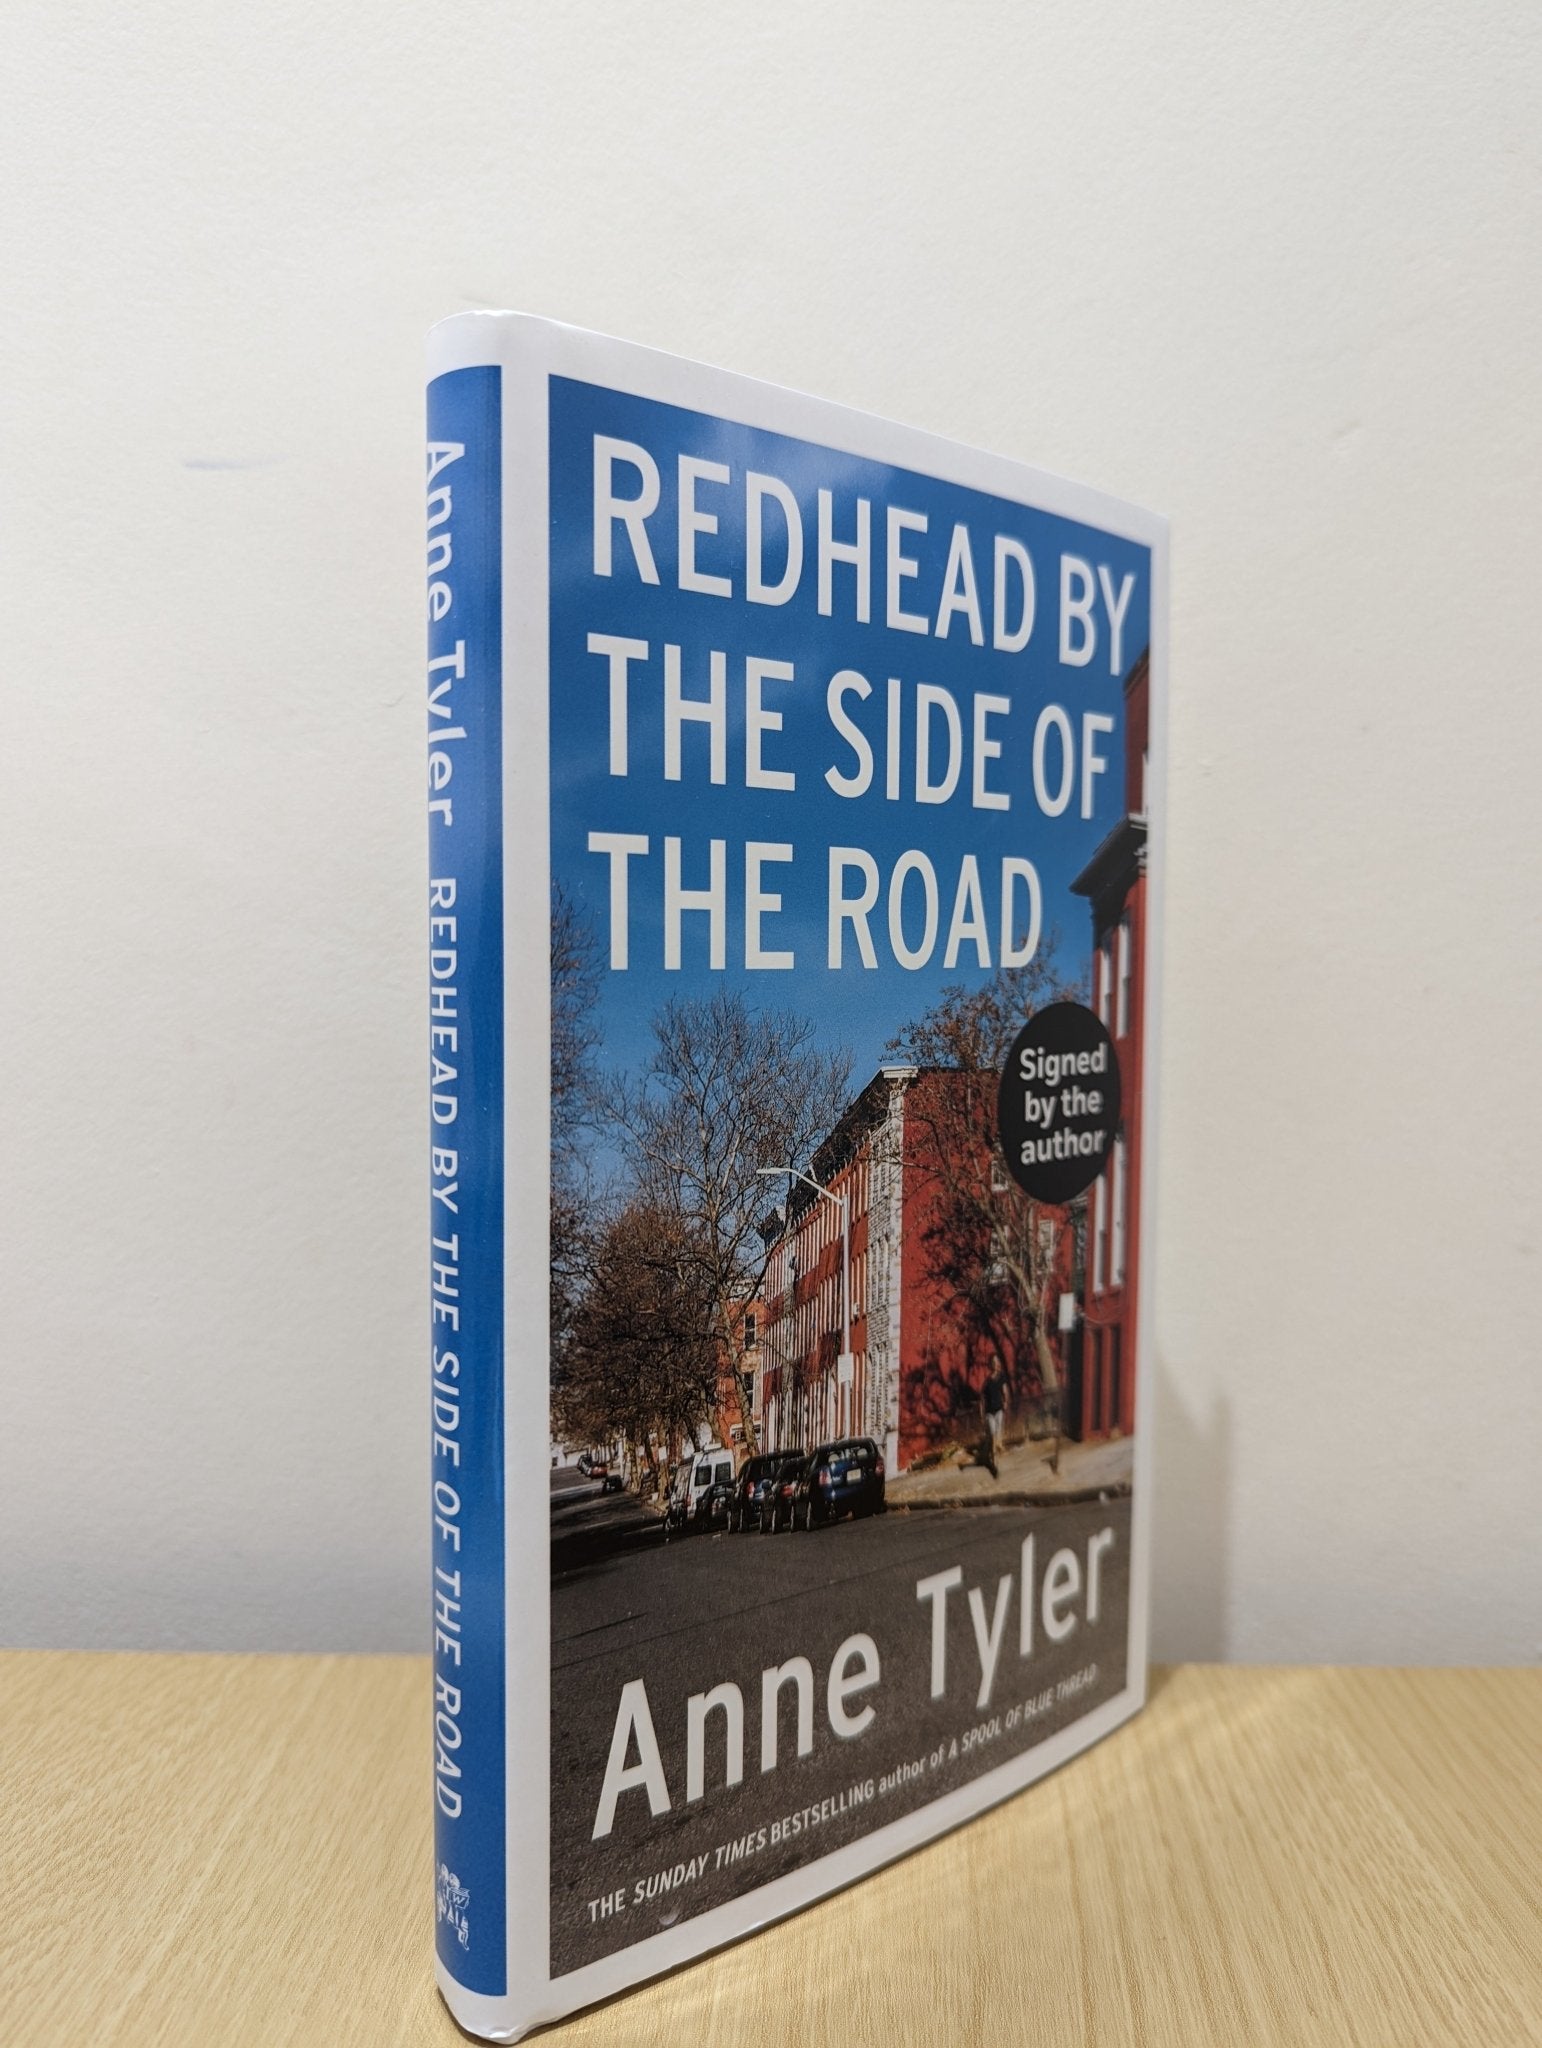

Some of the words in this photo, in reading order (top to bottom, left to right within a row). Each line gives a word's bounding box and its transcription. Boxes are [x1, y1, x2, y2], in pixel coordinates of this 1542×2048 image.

[427, 441, 466, 623] Anne
[592, 433, 1036, 653] REDHEAD
[1058, 553, 1135, 677] BY
[427, 640, 468, 827] Tyler
[587, 632, 796, 792] THE
[824, 670, 1011, 812] SIDE
[1032, 705, 1113, 820] OF
[587, 831, 796, 971] THE
[828, 849, 1042, 971] ROAD
[430, 878, 458, 1127] REDHEAD
[1019, 1042, 1109, 1087] Signed
[1020, 1126, 1106, 1165] author
[1024, 1090, 1057, 1129] by
[1060, 1084, 1103, 1118] the
[432, 1146, 459, 1215] BY
[432, 1234, 460, 1333] THE
[432, 1346, 461, 1468] SIDE
[434, 1480, 461, 1552] OF
[435, 1566, 462, 1666] THE
[591, 1632, 881, 1841] Anne
[915, 1526, 1113, 1709] Tyler
[435, 1675, 463, 1819] ROAD
[587, 1888, 626, 1923] THE
[633, 1852, 710, 1904] SUNDAY
[714, 1827, 768, 1871] TIMES
[769, 1779, 875, 1847] BESTSELLING
[878, 1756, 927, 1794] author
[929, 1744, 945, 1768] of
[946, 1738, 958, 1760] A
[961, 1716, 1002, 1752] SPOOL
[1004, 1704, 1023, 1729] OF
[1024, 1686, 1054, 1720] BLUE
[1055, 1662, 1098, 1701] THREAD
